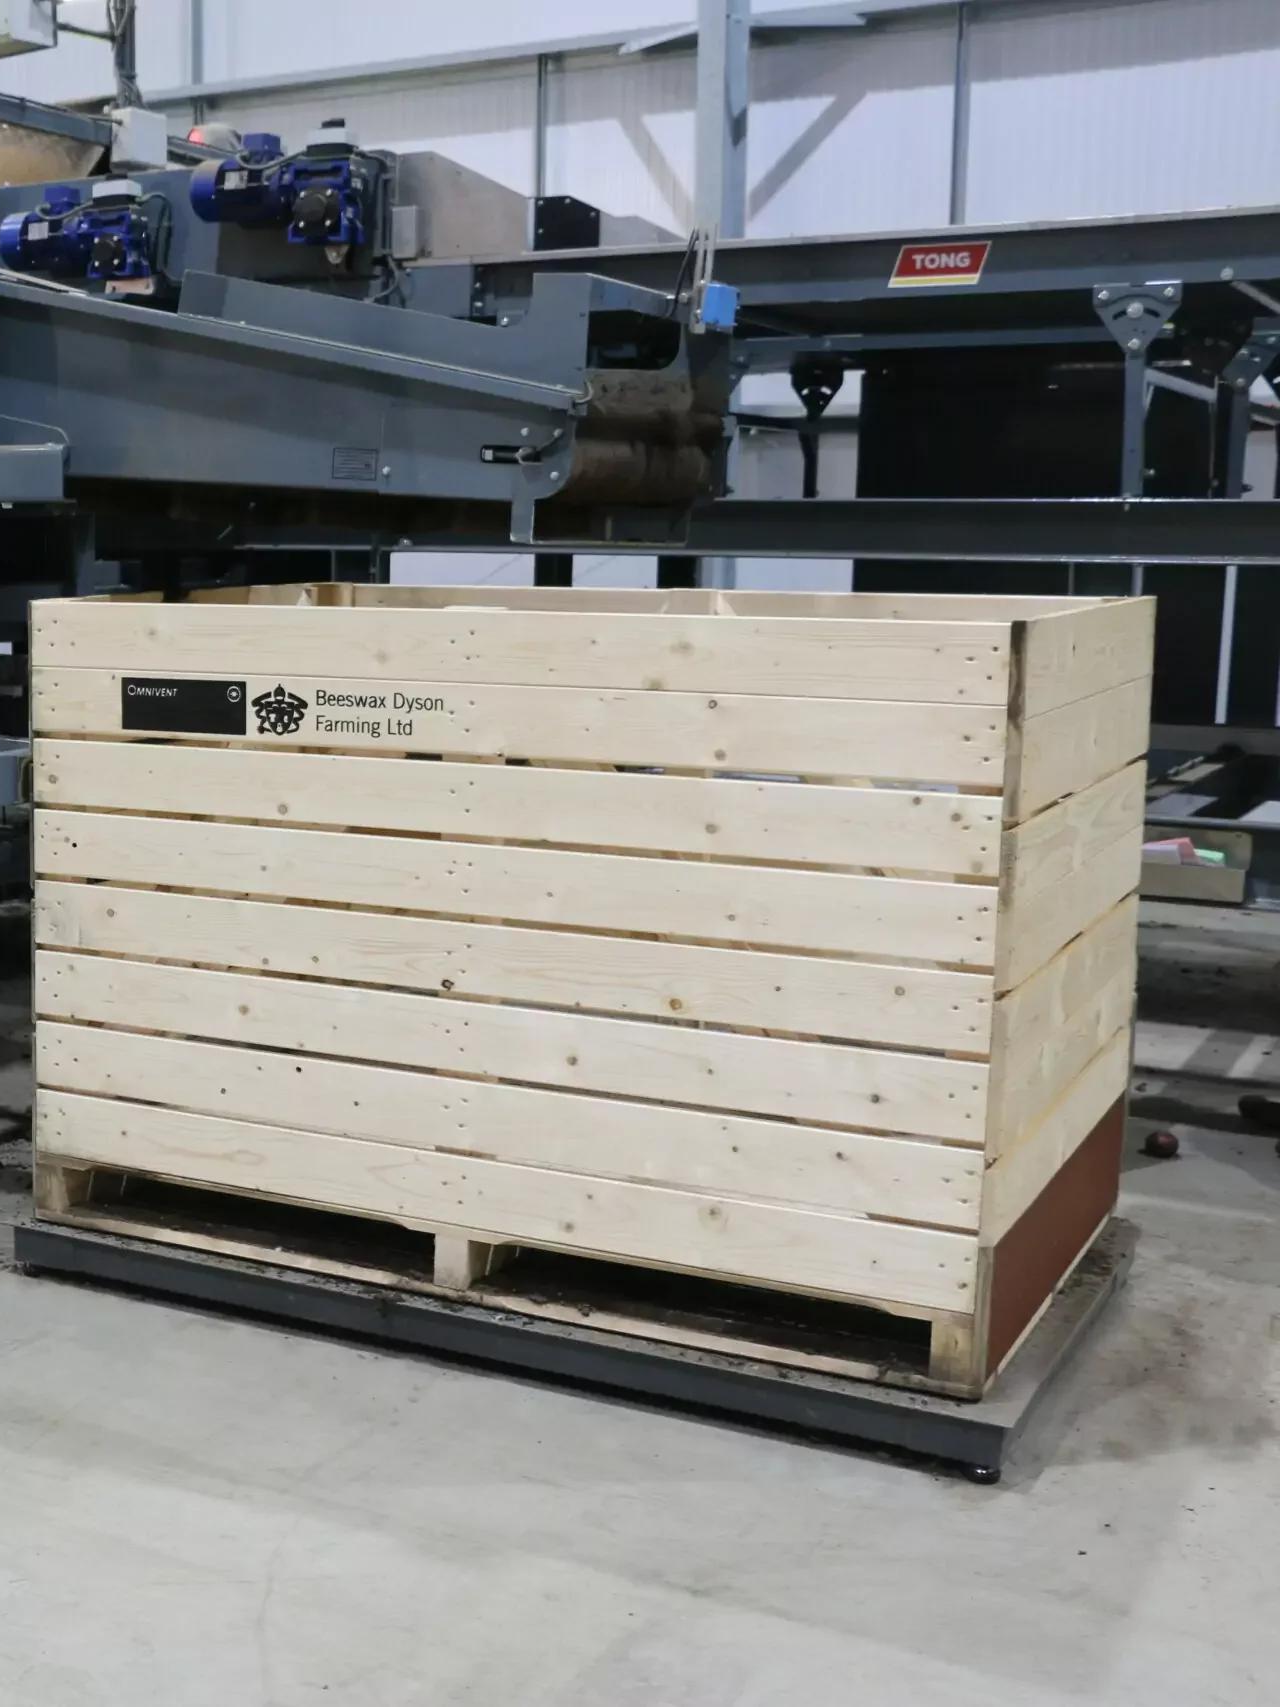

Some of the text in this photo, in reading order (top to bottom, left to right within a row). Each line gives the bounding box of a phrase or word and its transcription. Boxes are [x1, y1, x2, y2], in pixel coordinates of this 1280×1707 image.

[911, 251, 971, 270] TONG
[315, 689, 444, 713] Beeswax Dyson
[315, 715, 413, 738] Farming Ltd
